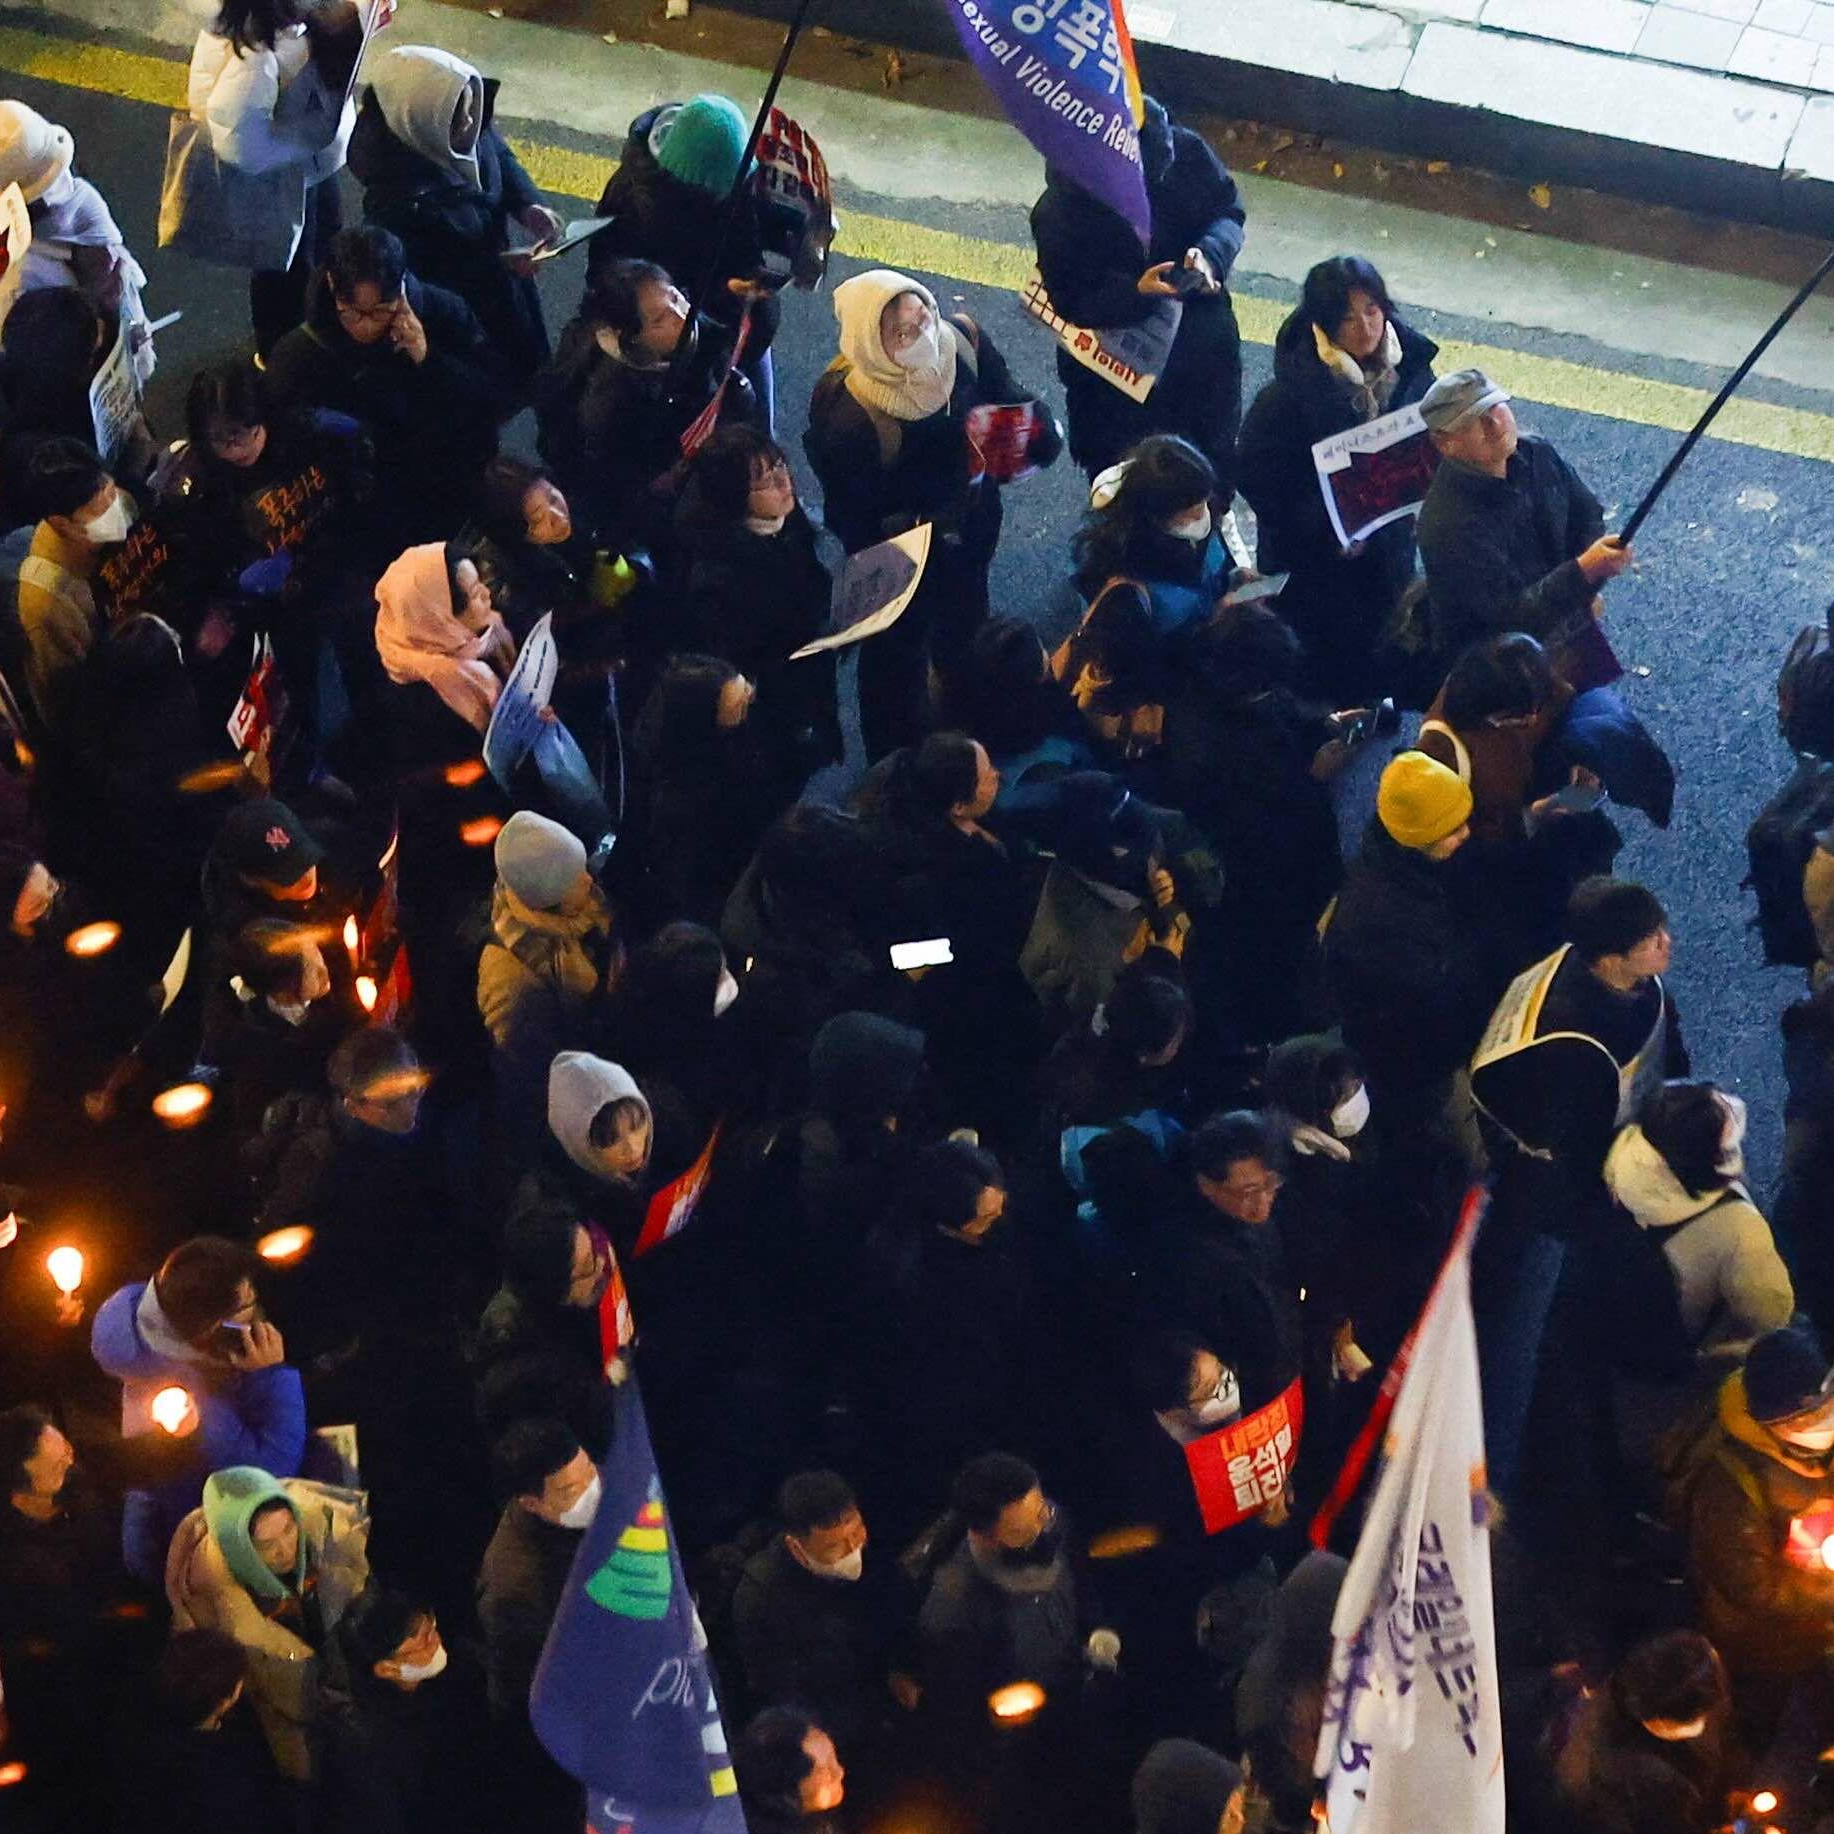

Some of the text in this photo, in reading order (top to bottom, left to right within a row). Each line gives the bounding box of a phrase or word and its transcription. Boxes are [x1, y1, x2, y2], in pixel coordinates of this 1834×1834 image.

[957, 0, 1022, 66] exual
[1015, 55, 1105, 135] Violence
[1227, 1423, 1293, 1484] 윤석열
